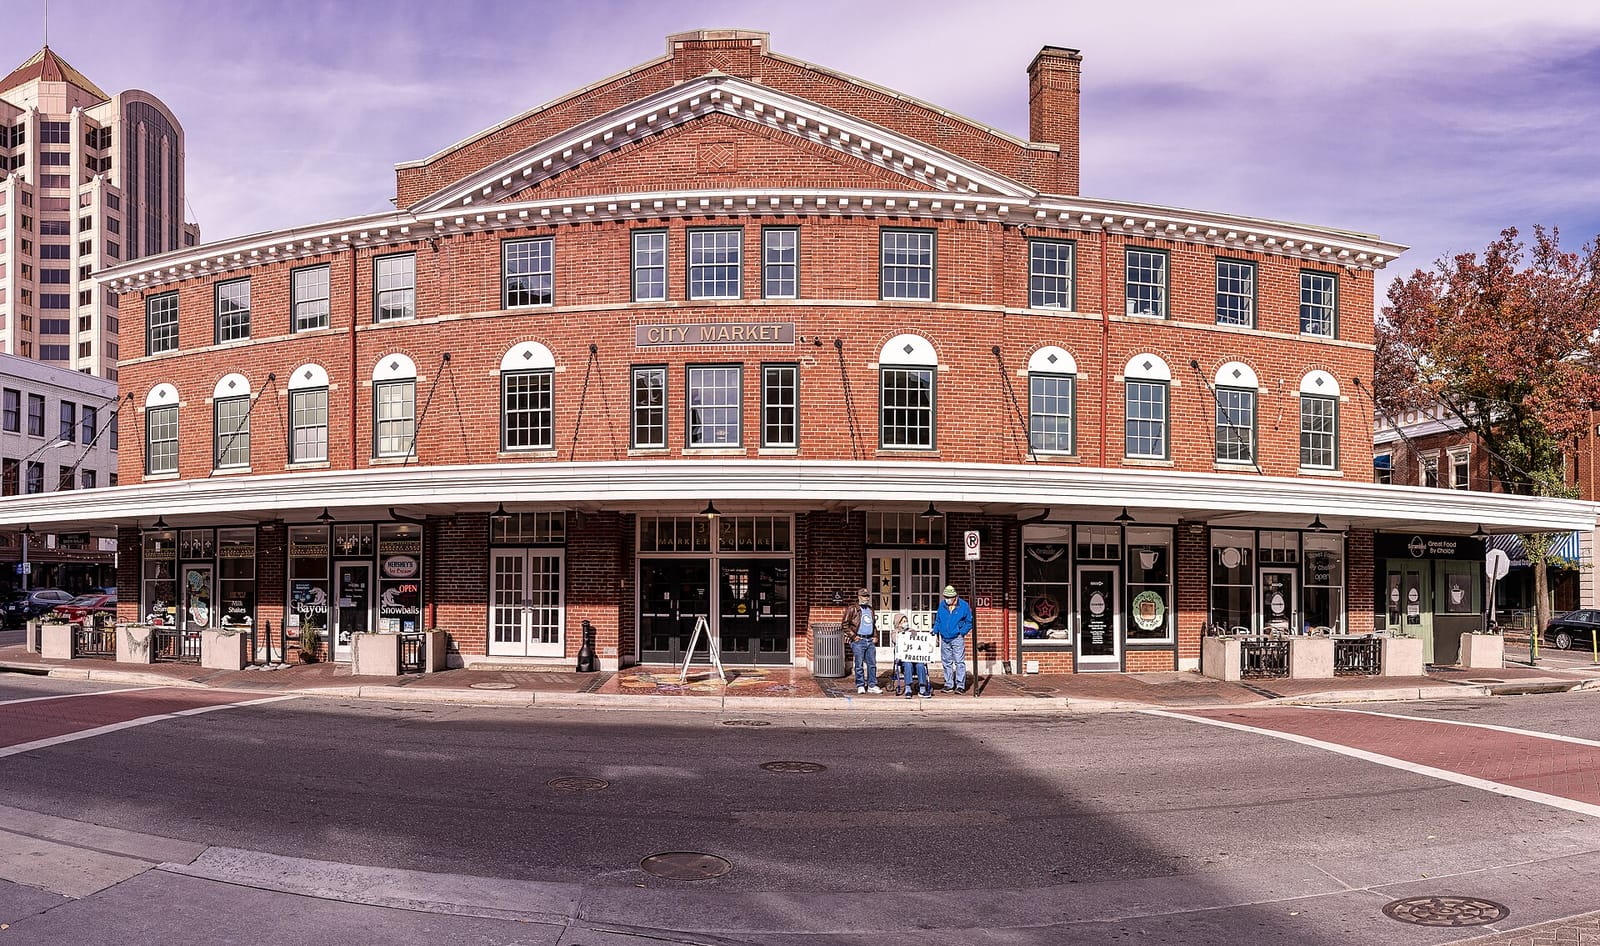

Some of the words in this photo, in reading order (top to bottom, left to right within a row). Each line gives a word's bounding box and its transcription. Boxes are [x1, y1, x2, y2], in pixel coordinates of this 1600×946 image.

[647, 328, 690, 342] CITY
[700, 325, 782, 341] MARKET
[399, 584, 418, 592] OPEN
[380, 605, 420, 615] Snowballs
[904, 654, 931, 662] PRACTICE
